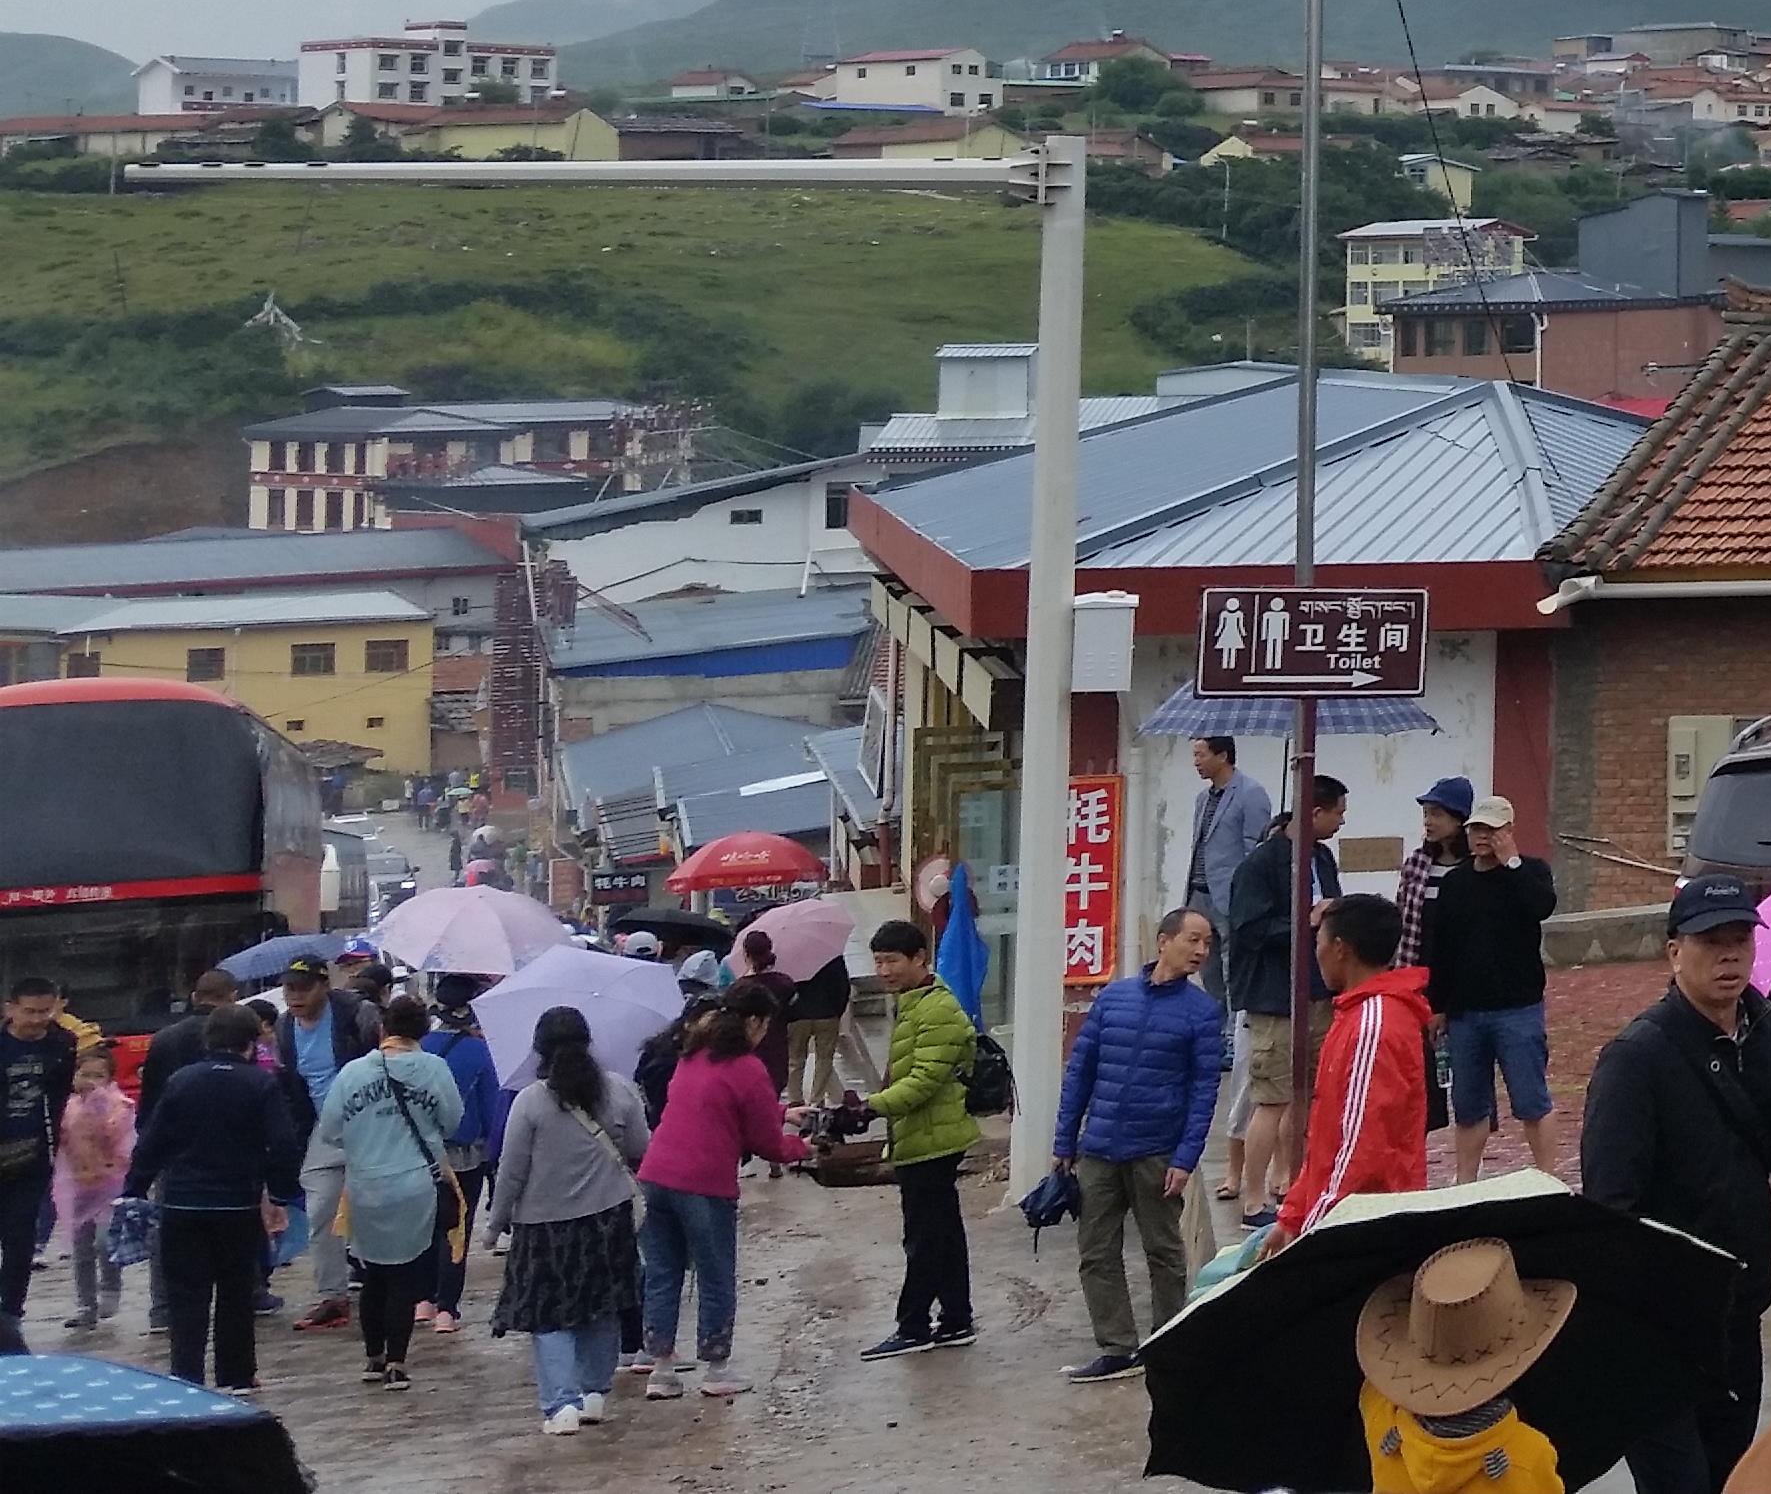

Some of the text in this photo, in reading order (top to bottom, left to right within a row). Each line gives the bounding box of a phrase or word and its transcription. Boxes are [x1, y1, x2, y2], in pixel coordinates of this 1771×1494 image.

[1294, 622, 1410, 652] 卫生间
[1326, 653, 1382, 669] Toilet
